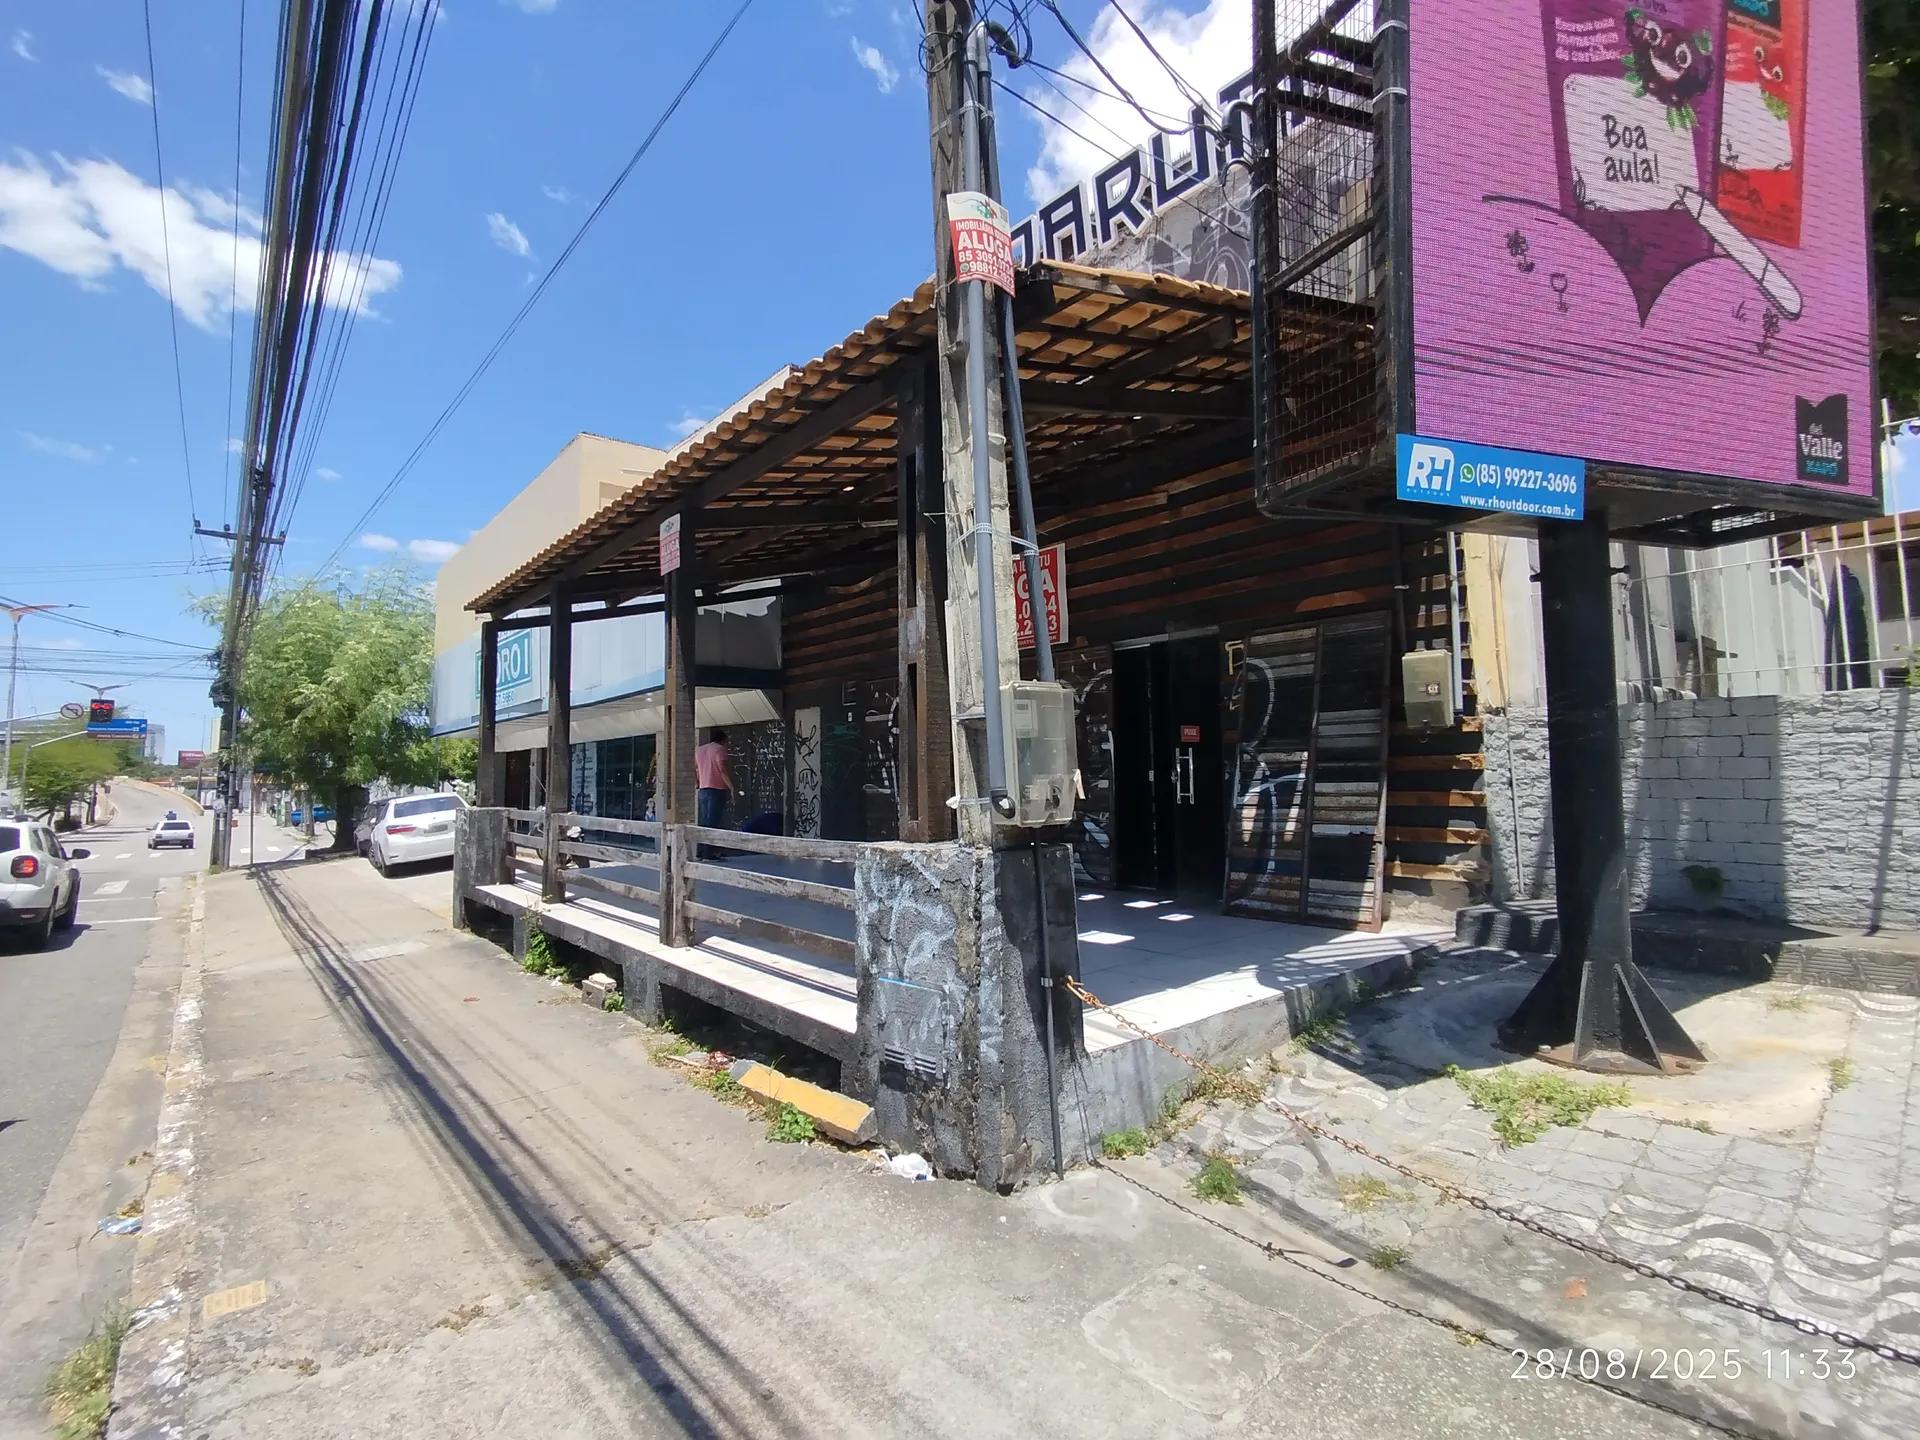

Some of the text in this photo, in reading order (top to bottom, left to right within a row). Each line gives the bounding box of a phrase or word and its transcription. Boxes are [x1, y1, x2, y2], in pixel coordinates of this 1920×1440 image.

[1601, 113, 1649, 151] Boa
[1603, 151, 1660, 185] aula!
[958, 231, 1013, 266] ALUGA
[959, 249, 973, 263] 85
[1798, 433, 1843, 460] Valle
[1406, 443, 1577, 495] RH (85) 99227-3696
[1460, 494, 1576, 517] www.rhoutdoor.com.br
